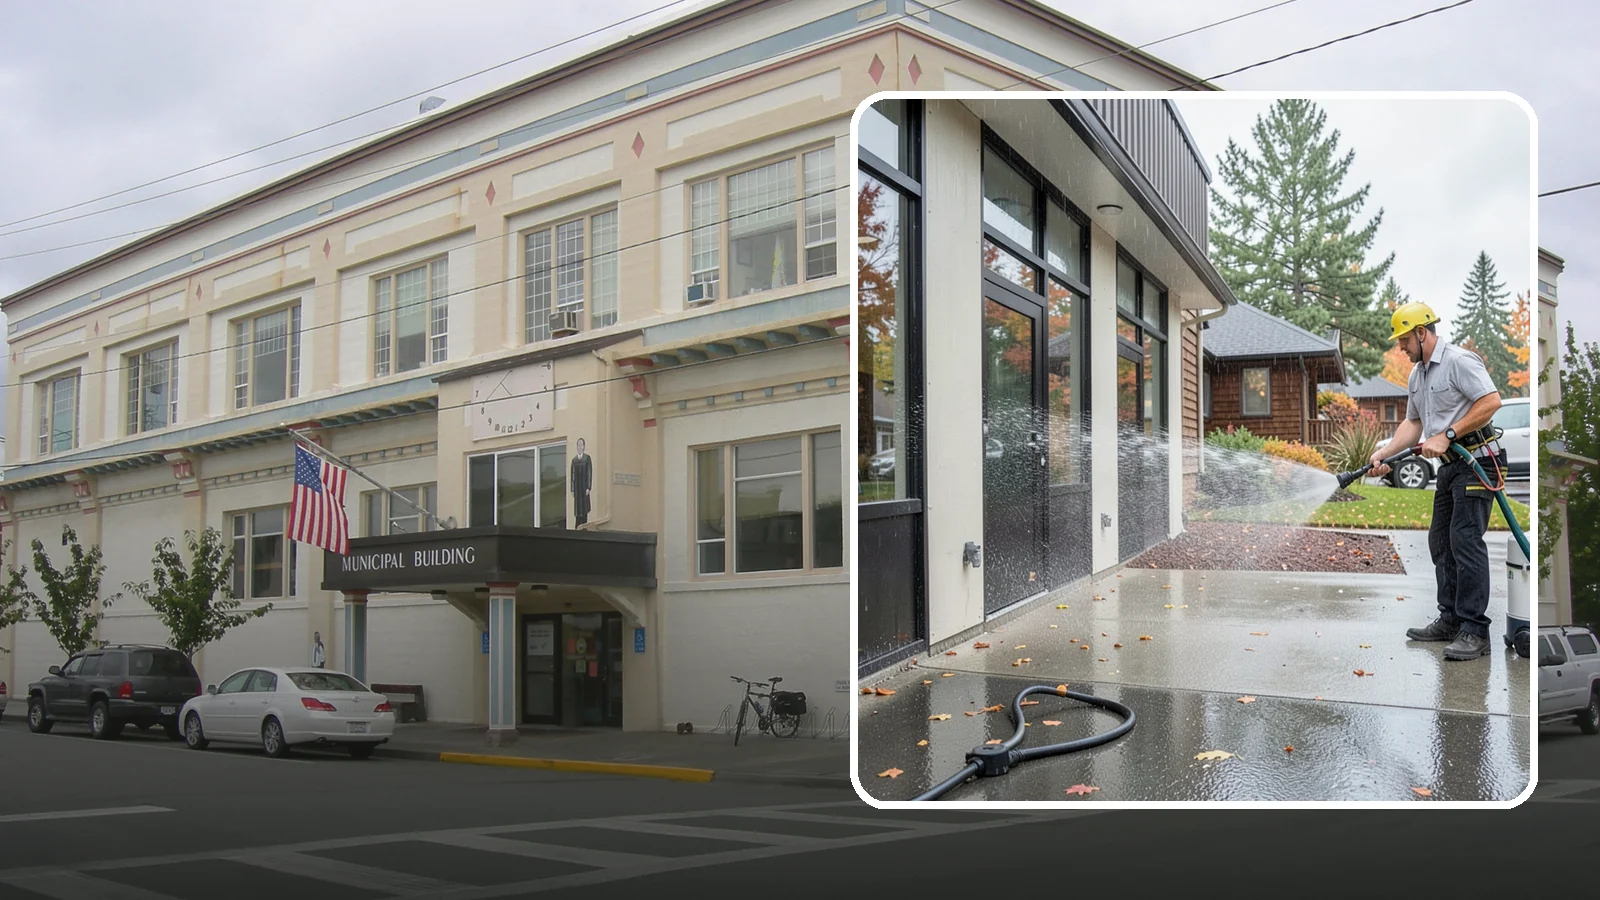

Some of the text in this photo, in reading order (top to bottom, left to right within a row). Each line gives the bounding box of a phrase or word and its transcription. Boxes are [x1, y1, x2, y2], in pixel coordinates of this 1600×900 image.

[480, 406, 484, 414] 8
[536, 402, 540, 410] 4
[488, 417, 492, 426] 9
[521, 420, 525, 428] 2
[494, 424, 500, 432] 10
[342, 546, 475, 572] MUNICIPAL BUILDING
